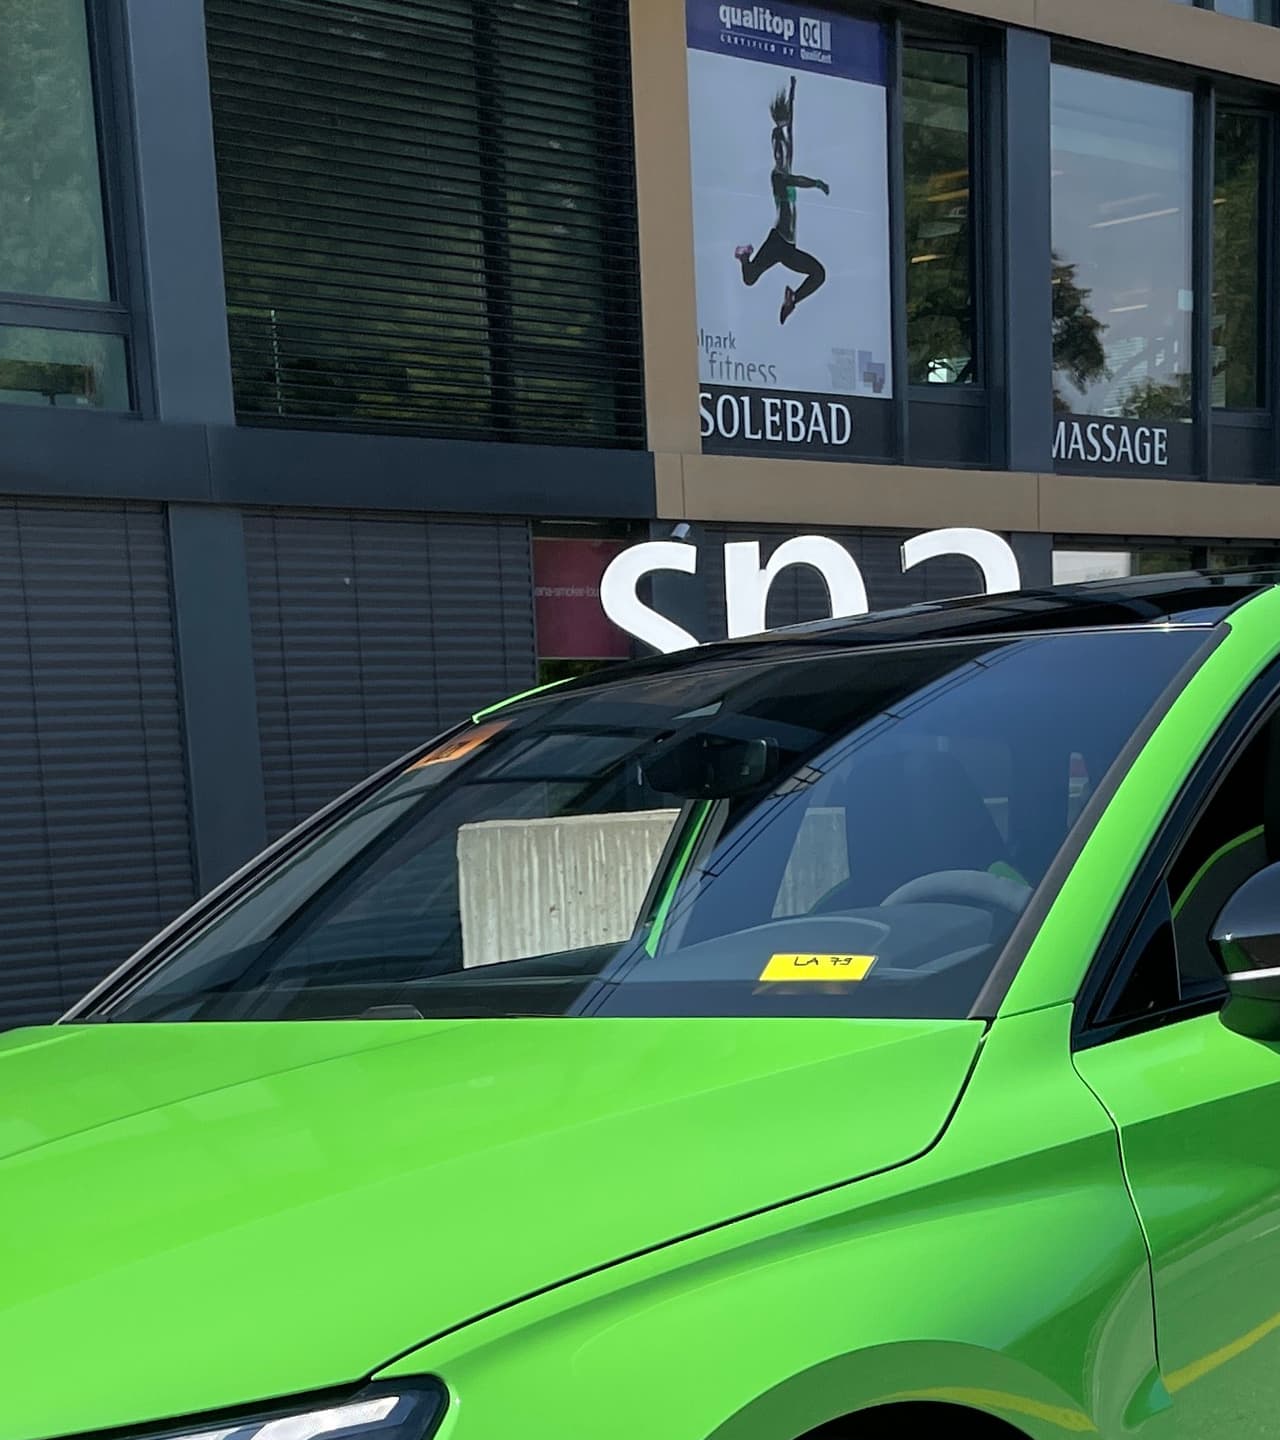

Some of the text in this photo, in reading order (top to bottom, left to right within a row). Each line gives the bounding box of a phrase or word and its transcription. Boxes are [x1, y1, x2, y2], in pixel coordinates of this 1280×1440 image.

[719, 4, 795, 41] qualitop
[696, 328, 737, 353] lpark
[708, 351, 777, 384] fitness
[699, 392, 852, 445] SOLEBAD
[793, 956, 818, 967] LA
